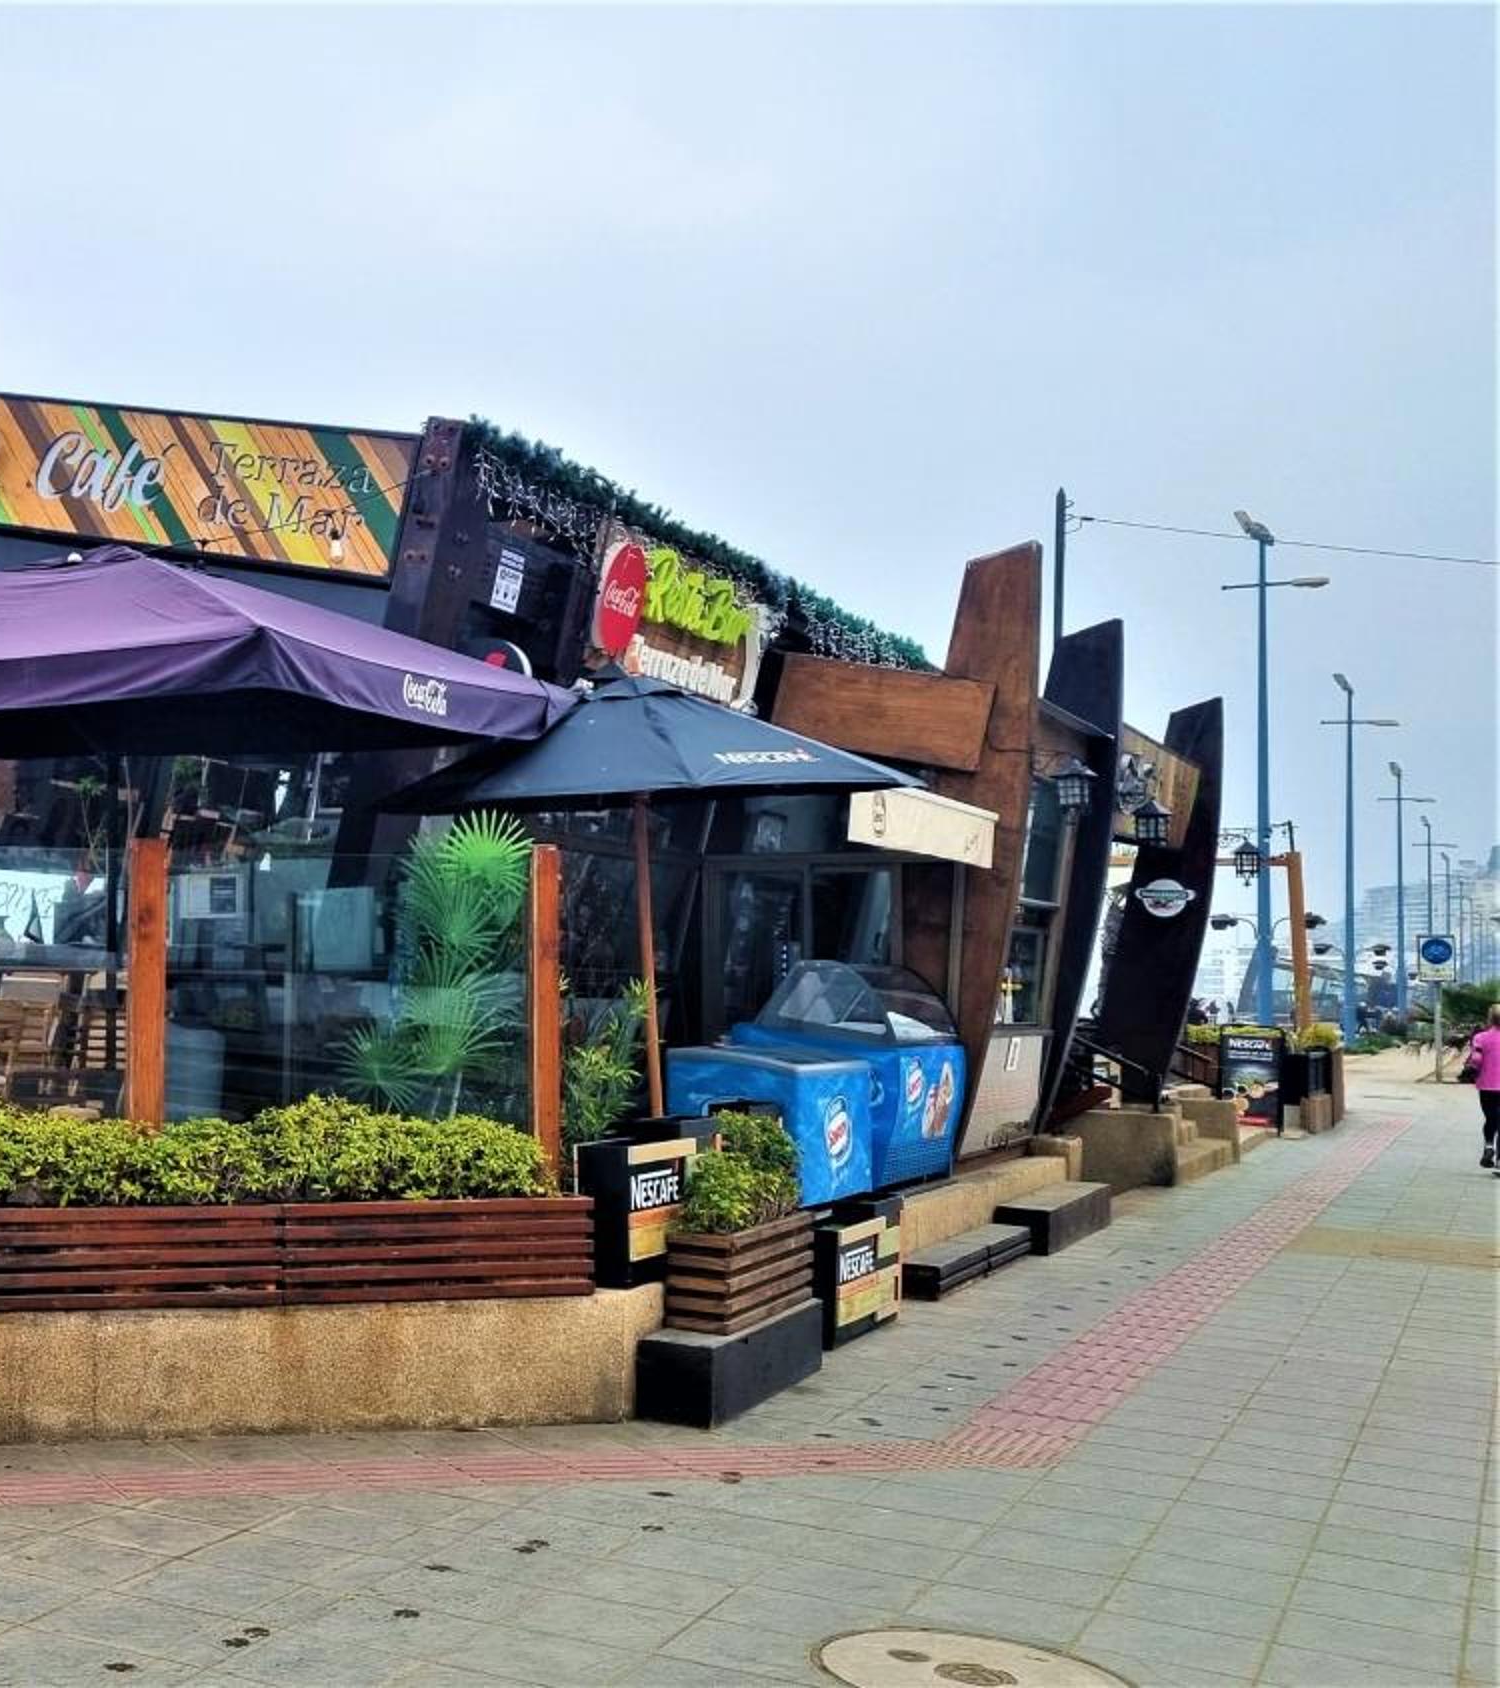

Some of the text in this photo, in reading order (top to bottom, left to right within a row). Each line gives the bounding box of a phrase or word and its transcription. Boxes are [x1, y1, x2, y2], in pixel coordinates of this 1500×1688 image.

[209, 441, 372, 494] Terraza
[197, 484, 364, 538] de Mar
[403, 673, 448, 716] Coca-Cola
